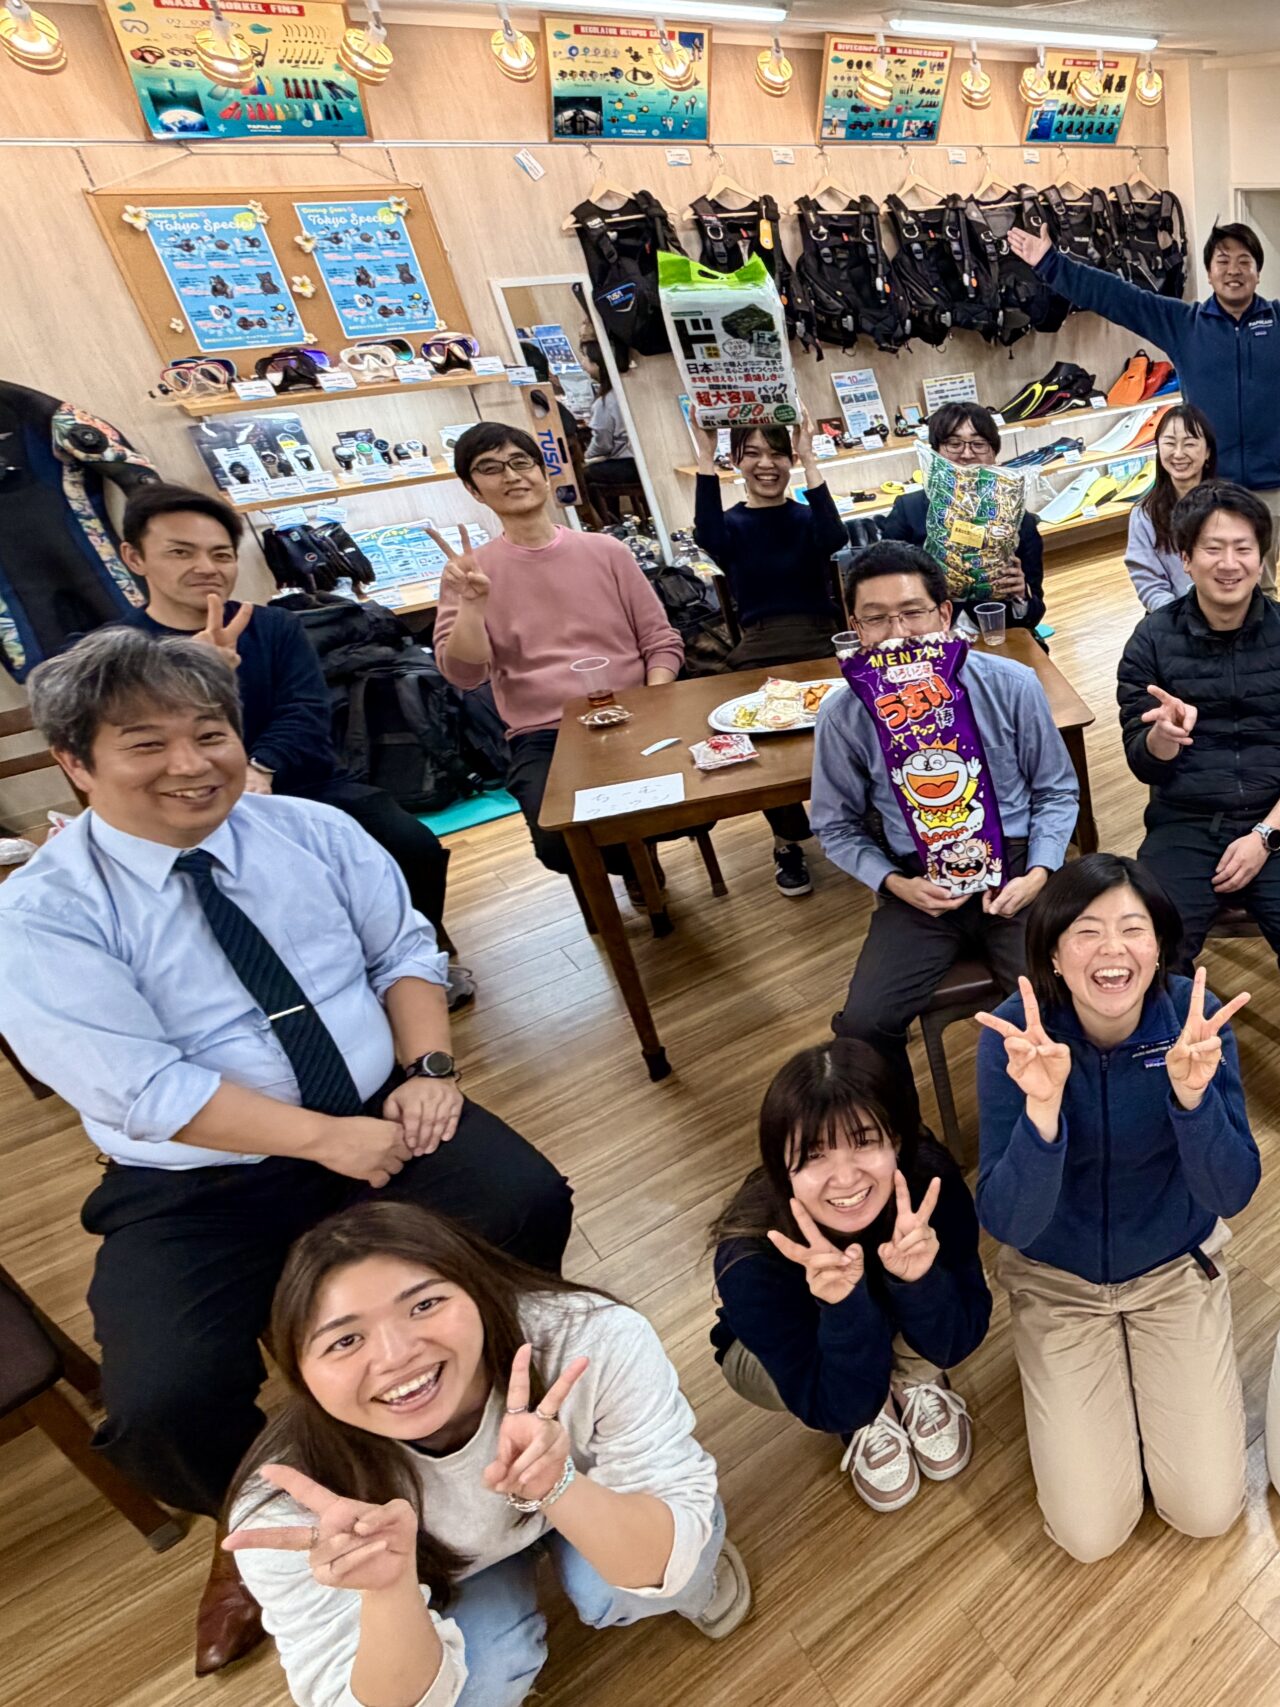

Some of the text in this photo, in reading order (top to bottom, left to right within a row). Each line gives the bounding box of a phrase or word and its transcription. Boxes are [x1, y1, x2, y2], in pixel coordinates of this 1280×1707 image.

[270, 4, 300, 14] FINS
[154, 219, 200, 234] Tokyo
[307, 214, 348, 228] Tokyo
[673, 318, 718, 360] ド
[686, 363, 714, 375] 日本
[537, 429, 562, 476] TUSA
[869, 644, 944, 668] MENTAI
